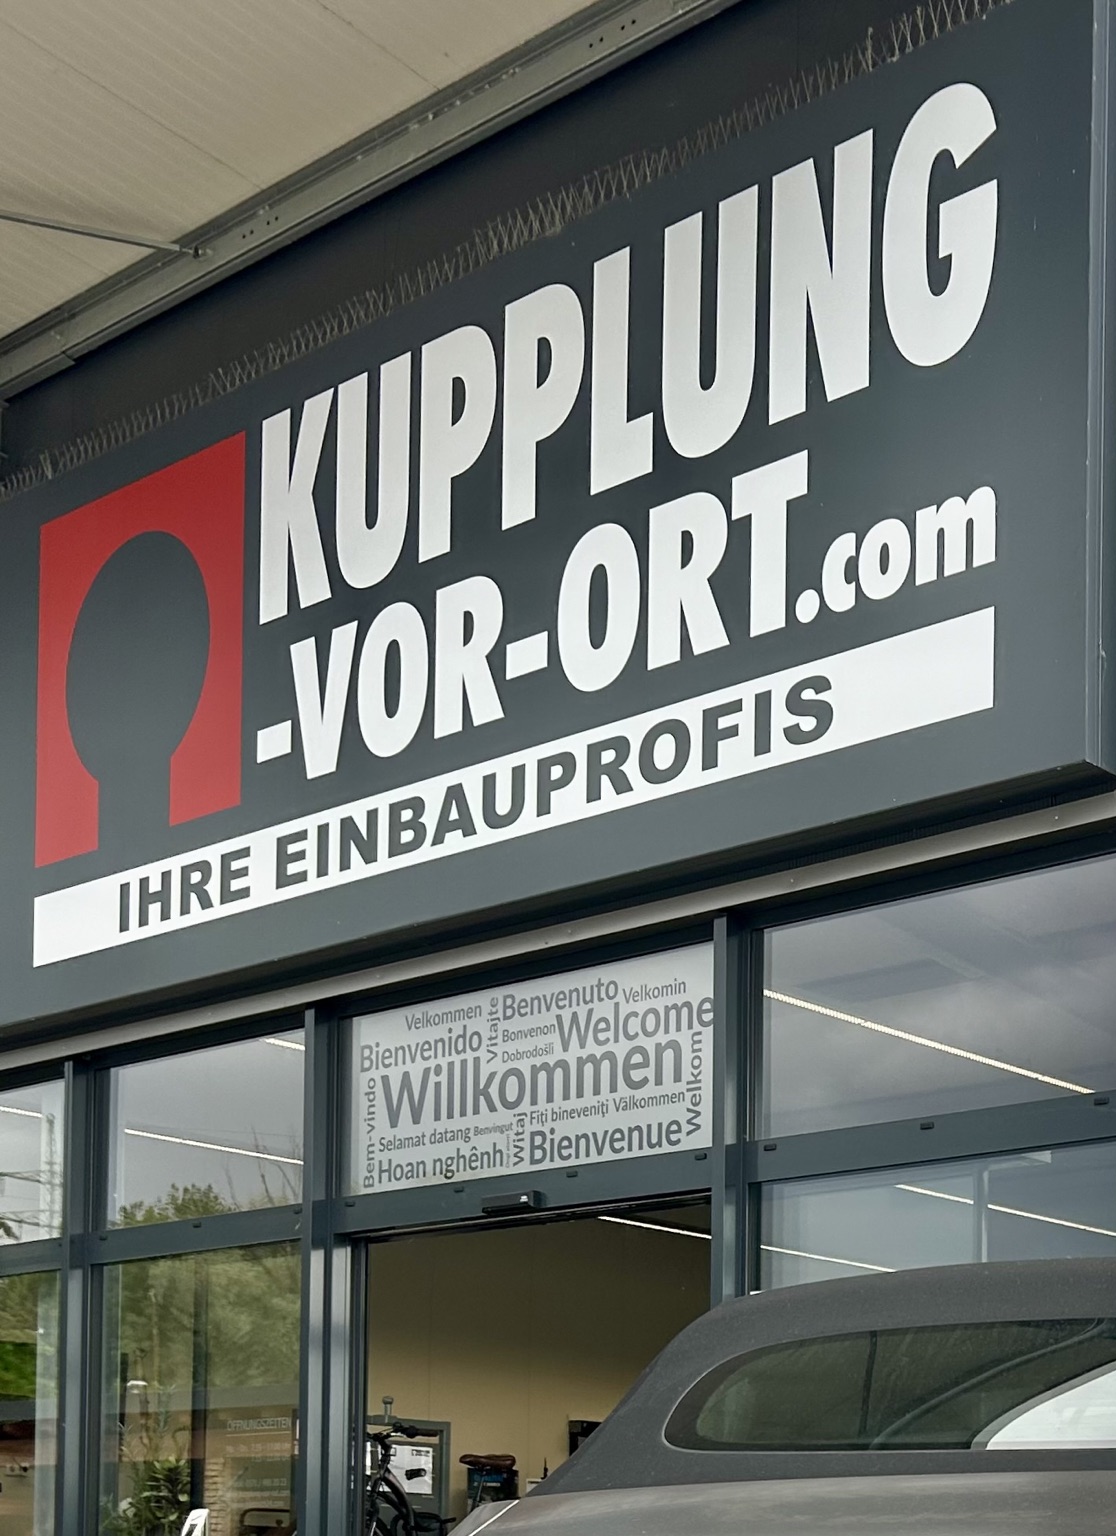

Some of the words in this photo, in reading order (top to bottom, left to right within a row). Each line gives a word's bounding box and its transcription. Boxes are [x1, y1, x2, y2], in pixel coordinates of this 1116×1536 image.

[260, 83, 998, 625] KUPPLUNG
[257, 450, 997, 780] -VOR-ORT.com
[119, 848, 251, 934] IHRE
[275, 675, 834, 889] EINBAUPROFIS
[502, 978, 619, 1022] Benvenuto
[622, 978, 687, 1005] Velkomin
[405, 1004, 482, 1032] Velkommen
[486, 997, 501, 1064] Vitajte
[502, 1022, 556, 1043] Bonvenon
[555, 996, 714, 1053] Welcome
[360, 1024, 483, 1073] Bienvenido
[502, 1041, 554, 1063] Dobrodošli
[381, 1039, 683, 1129] Willkommen
[613, 1091, 685, 1113] Välkommen
[686, 1031, 703, 1137] Welkom
[363, 1077, 377, 1189] Bem-vindo
[378, 1133, 427, 1152] Selamat
[429, 1127, 471, 1145] datang
[513, 1112, 528, 1167] Witaj
[529, 1119, 683, 1166] Bienvenue
[378, 1158, 427, 1184] Hoan
[432, 1142, 504, 1180] nghênh
